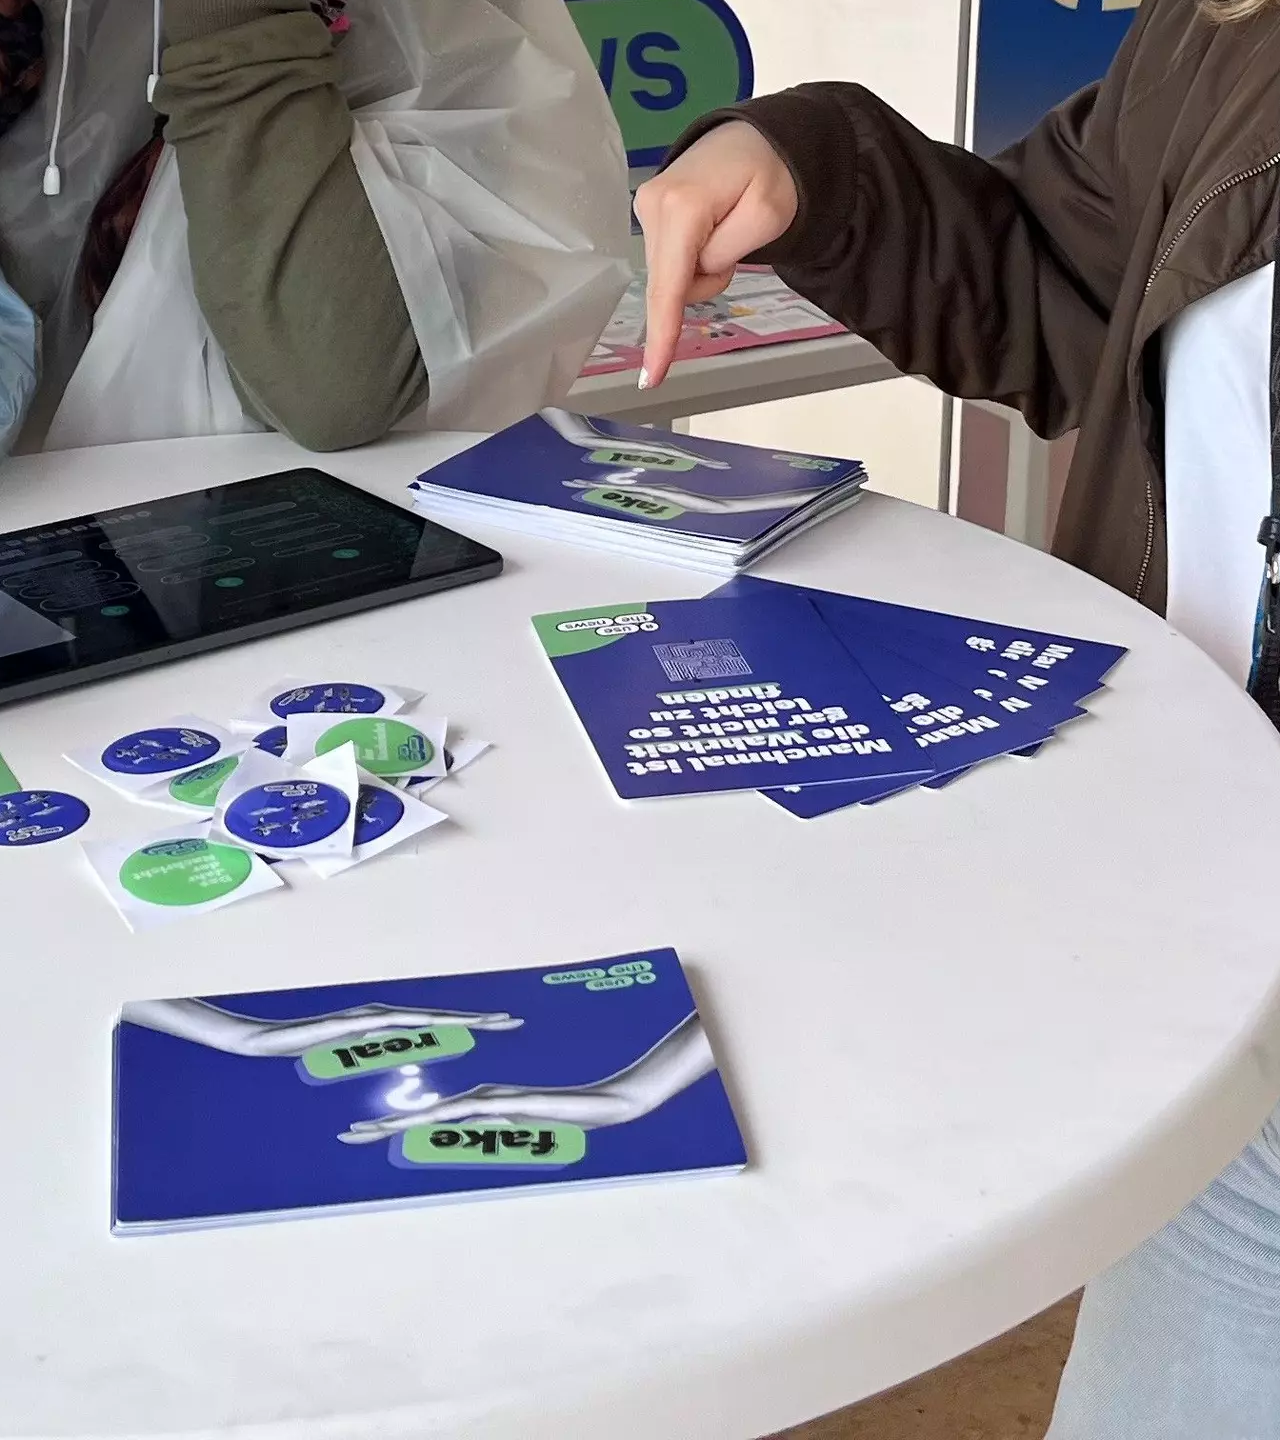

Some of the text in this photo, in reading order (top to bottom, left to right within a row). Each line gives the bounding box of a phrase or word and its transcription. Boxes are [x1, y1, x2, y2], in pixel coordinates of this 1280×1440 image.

[608, 452, 676, 466] real
[602, 491, 671, 515] fake
[565, 619, 607, 630] news
[660, 685, 782, 705] finden
[649, 697, 813, 722] leicht zu
[911, 705, 964, 726] die
[628, 707, 849, 739] gar nicht so
[624, 724, 870, 759] die Wahrheit
[626, 738, 893, 776] Manchmal ist
[331, 1031, 441, 1069] real
[429, 1129, 559, 1157] fake
